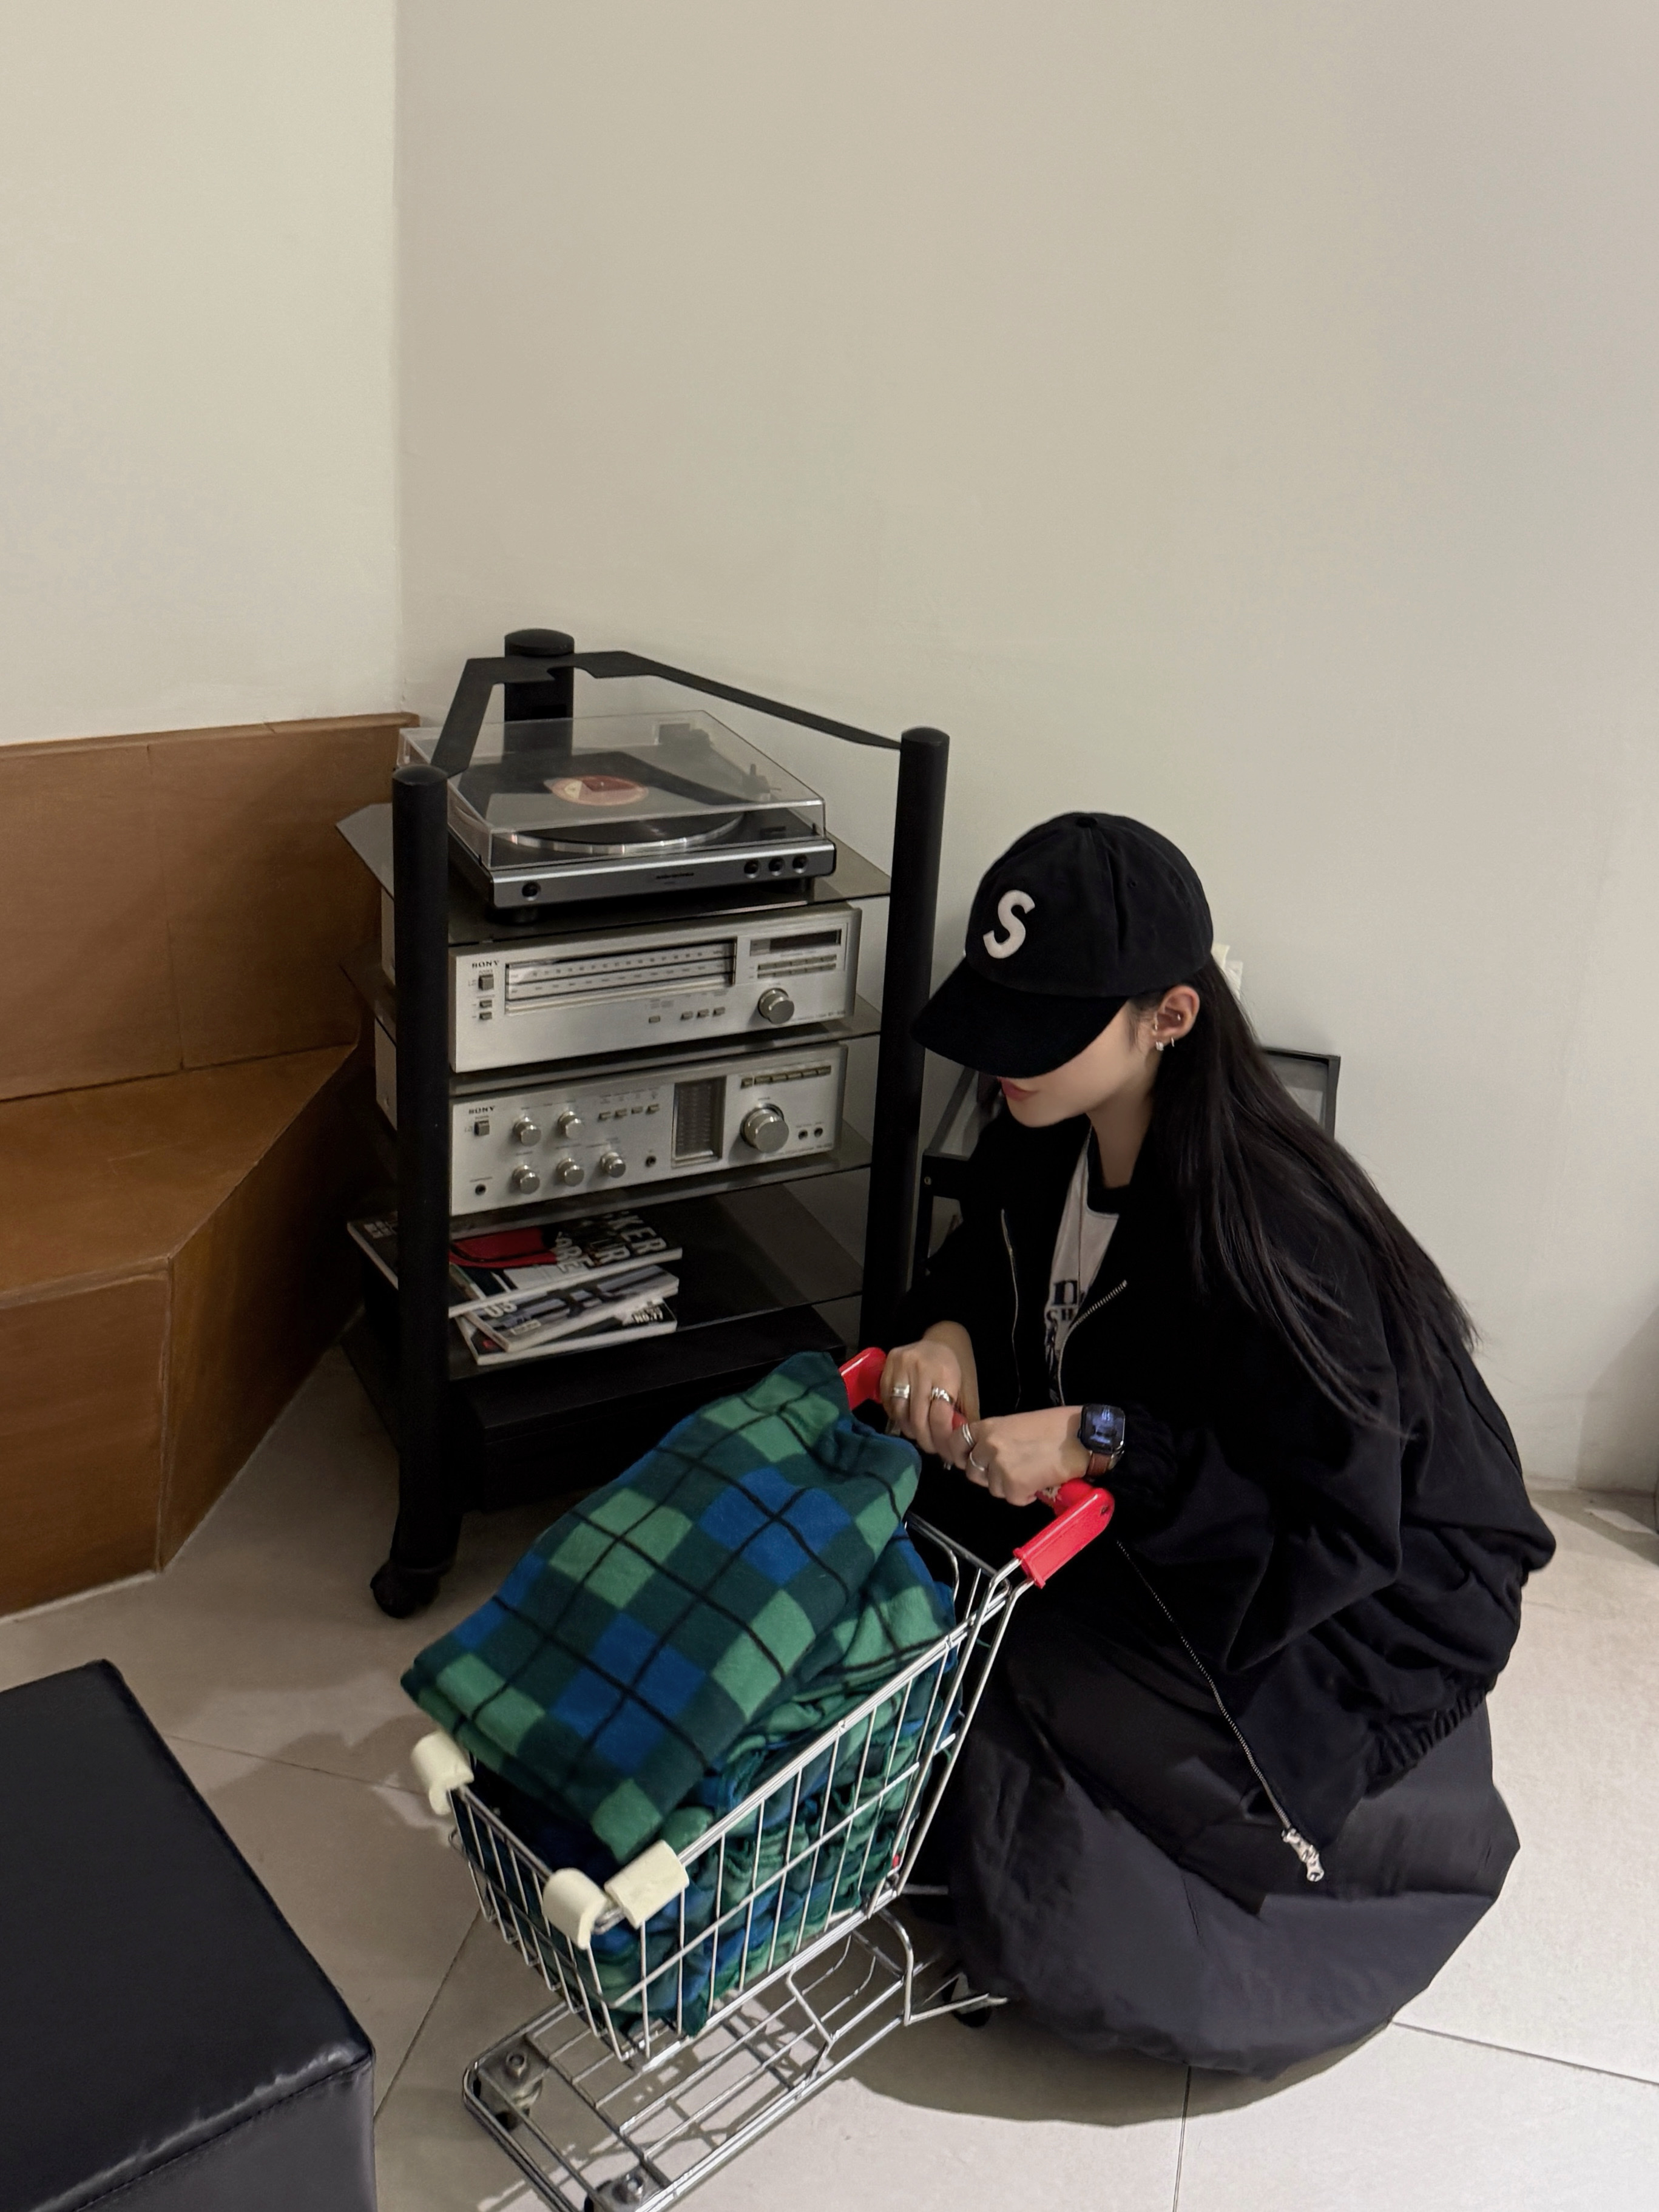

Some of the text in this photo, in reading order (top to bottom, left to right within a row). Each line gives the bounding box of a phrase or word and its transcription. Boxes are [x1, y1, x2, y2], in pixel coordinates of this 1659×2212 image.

[983, 889, 1035, 959] S
[471, 960, 499, 969] SONY
[468, 1106, 495, 1114] SONY
